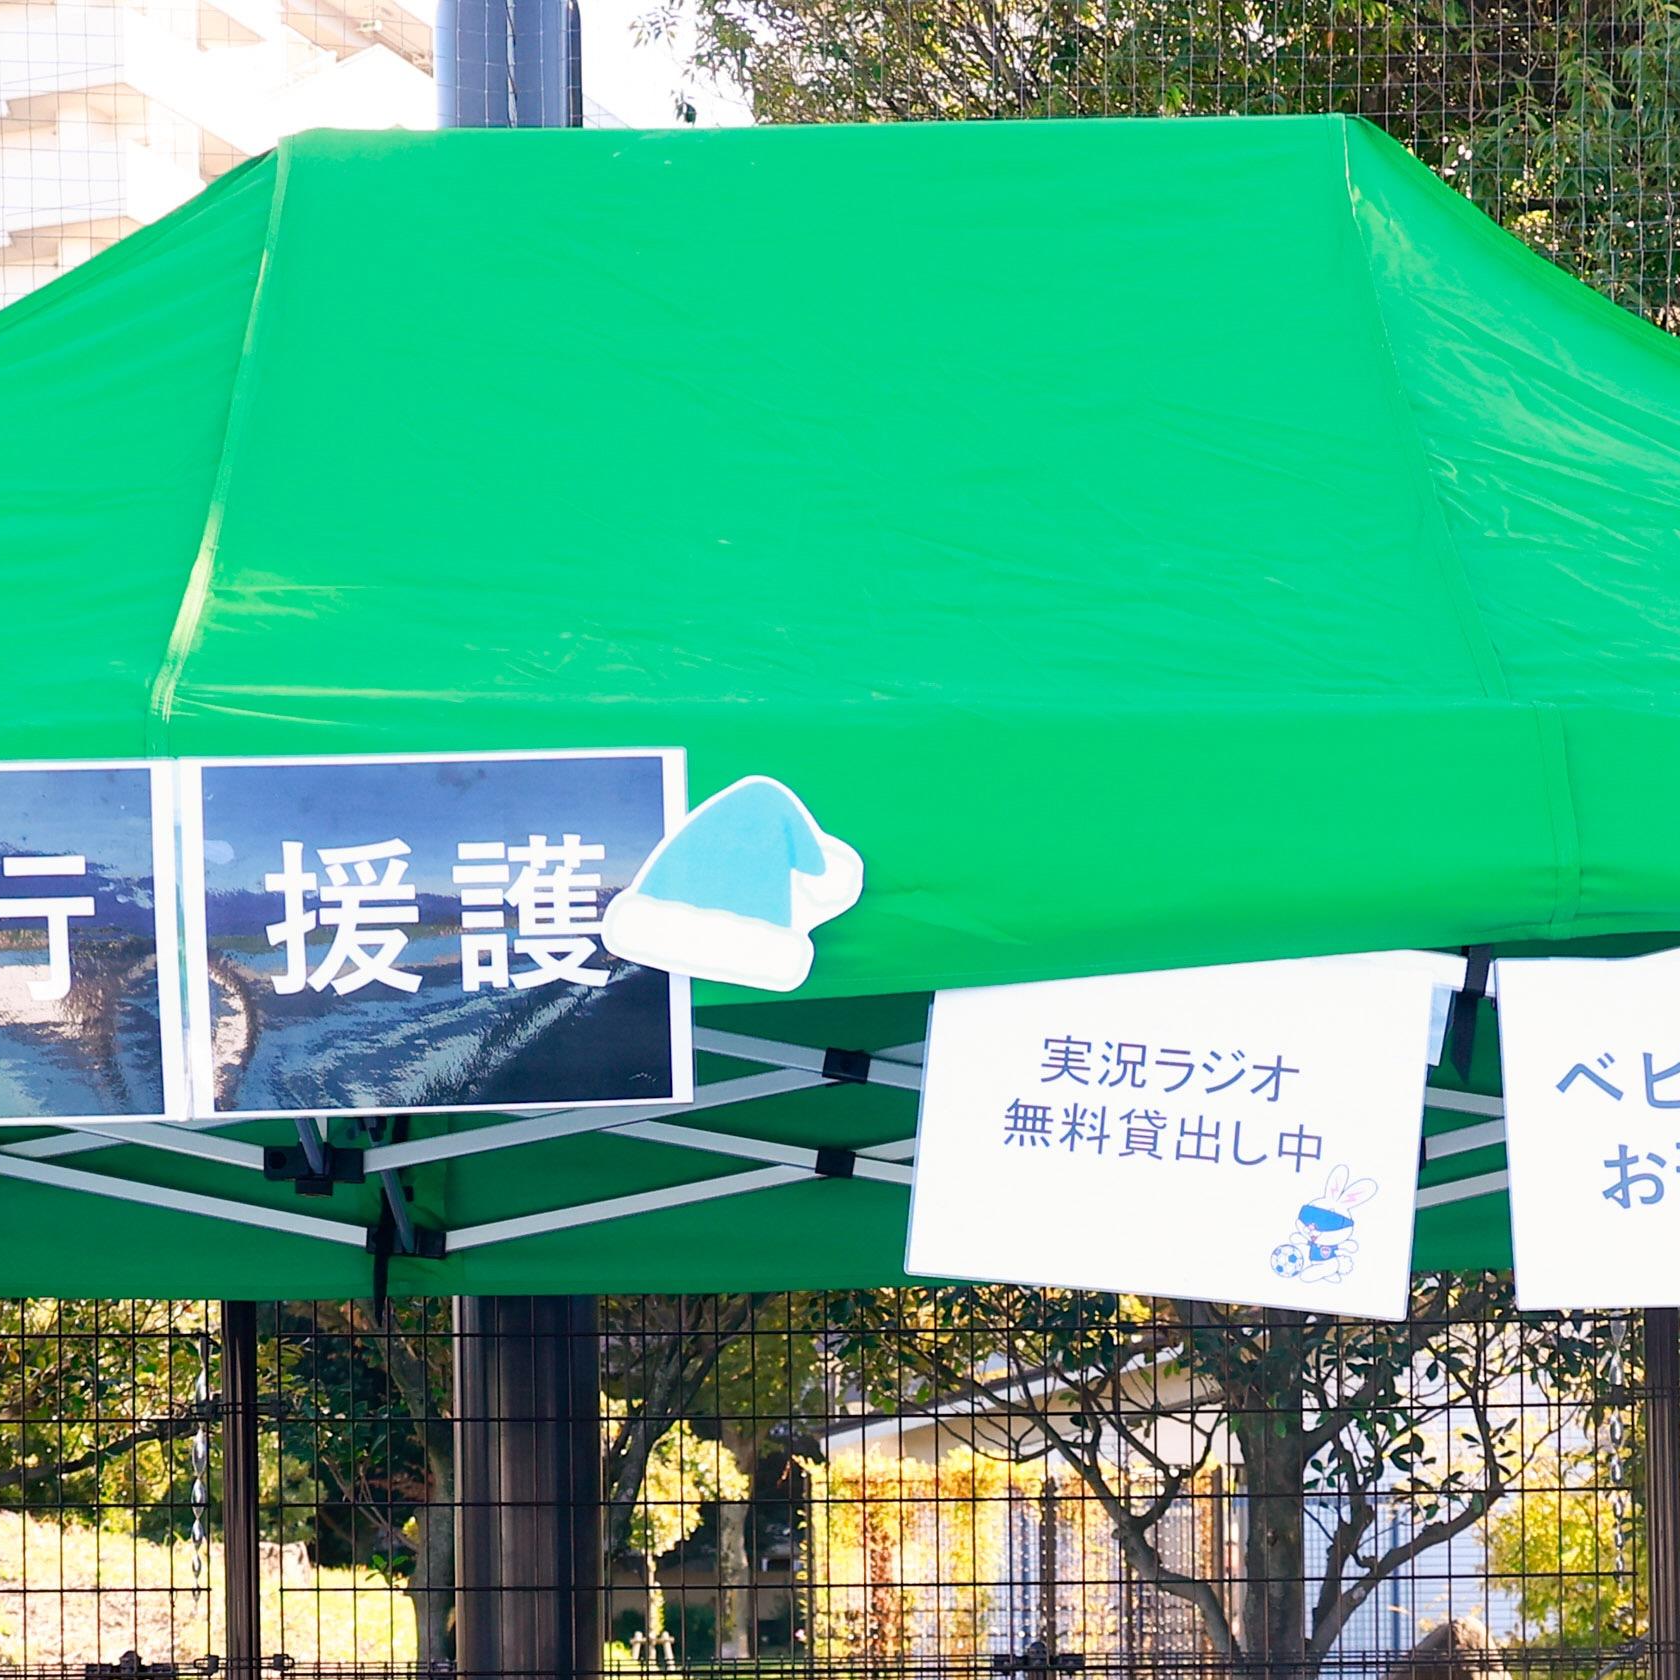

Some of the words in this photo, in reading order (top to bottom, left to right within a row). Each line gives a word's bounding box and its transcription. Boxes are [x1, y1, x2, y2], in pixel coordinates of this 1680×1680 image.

[264, 834, 612, 996] 援護
[1041, 1033, 1301, 1104] 実況ラジオ
[1002, 1098, 1324, 1175] 無料貸出し中
